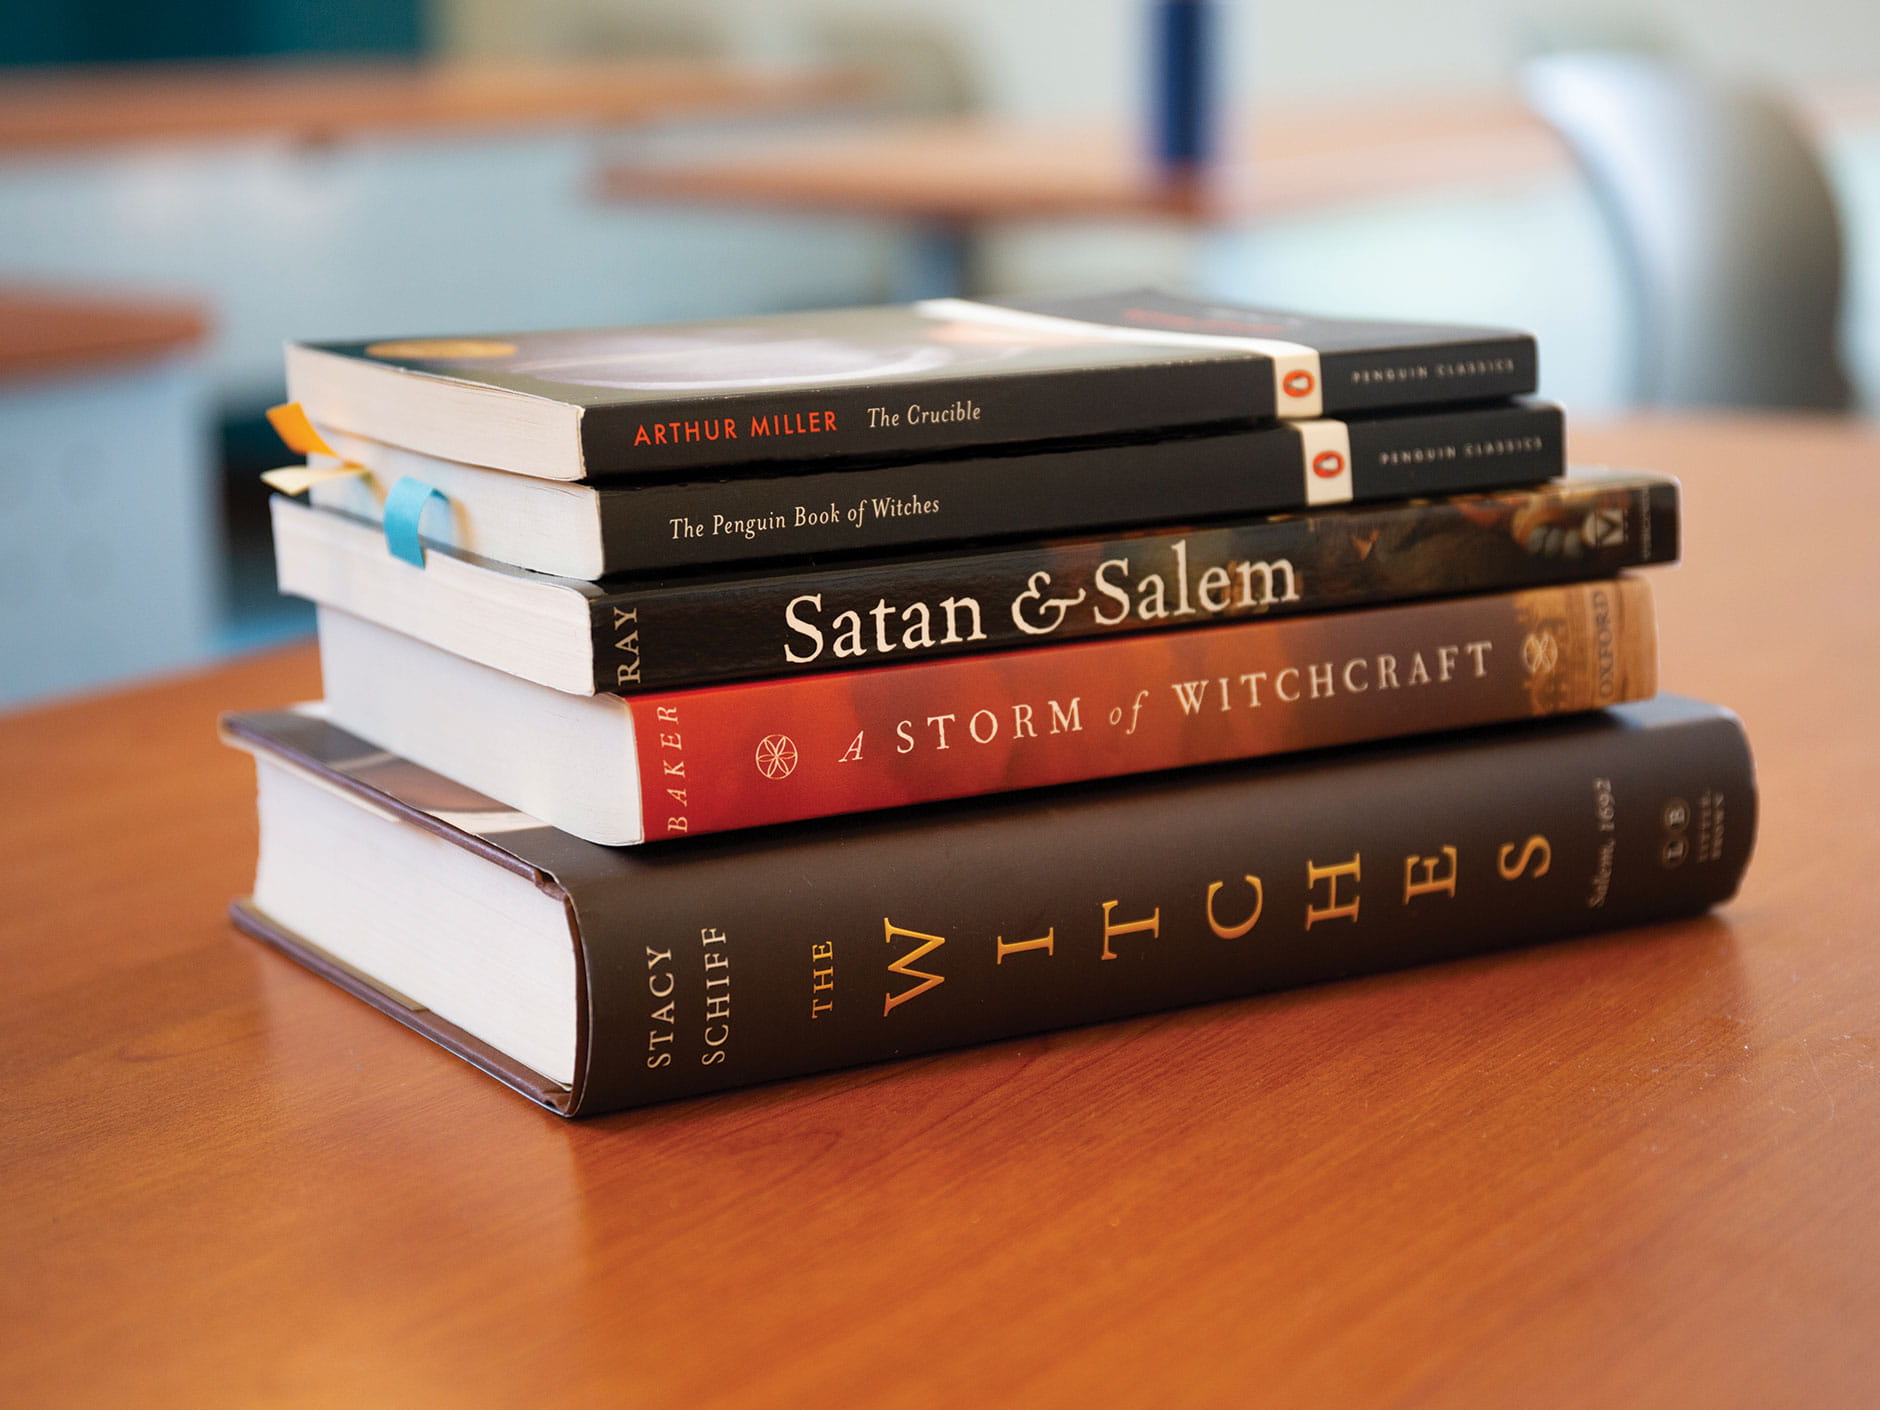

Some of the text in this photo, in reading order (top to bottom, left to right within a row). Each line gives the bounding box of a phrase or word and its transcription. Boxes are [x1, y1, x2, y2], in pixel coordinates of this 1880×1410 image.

[1352, 358, 1515, 384] PENGUIN CLASSICS
[633, 401, 982, 446] ARTHUR MILLER The Crucible
[1380, 437, 1543, 465] PENGUIN CLASSICS
[669, 495, 940, 540] The Penguin Book of Witches
[615, 606, 641, 686] RAY
[783, 540, 1300, 665] Satan & Salem
[1594, 591, 1614, 699] OXFORD
[838, 640, 1494, 763] A STORM of WITCHCRAFT
[655, 705, 689, 833] BAKER
[646, 945, 675, 1069] STACY
[701, 926, 731, 1065] SCHIFF
[811, 940, 834, 1019] THE
